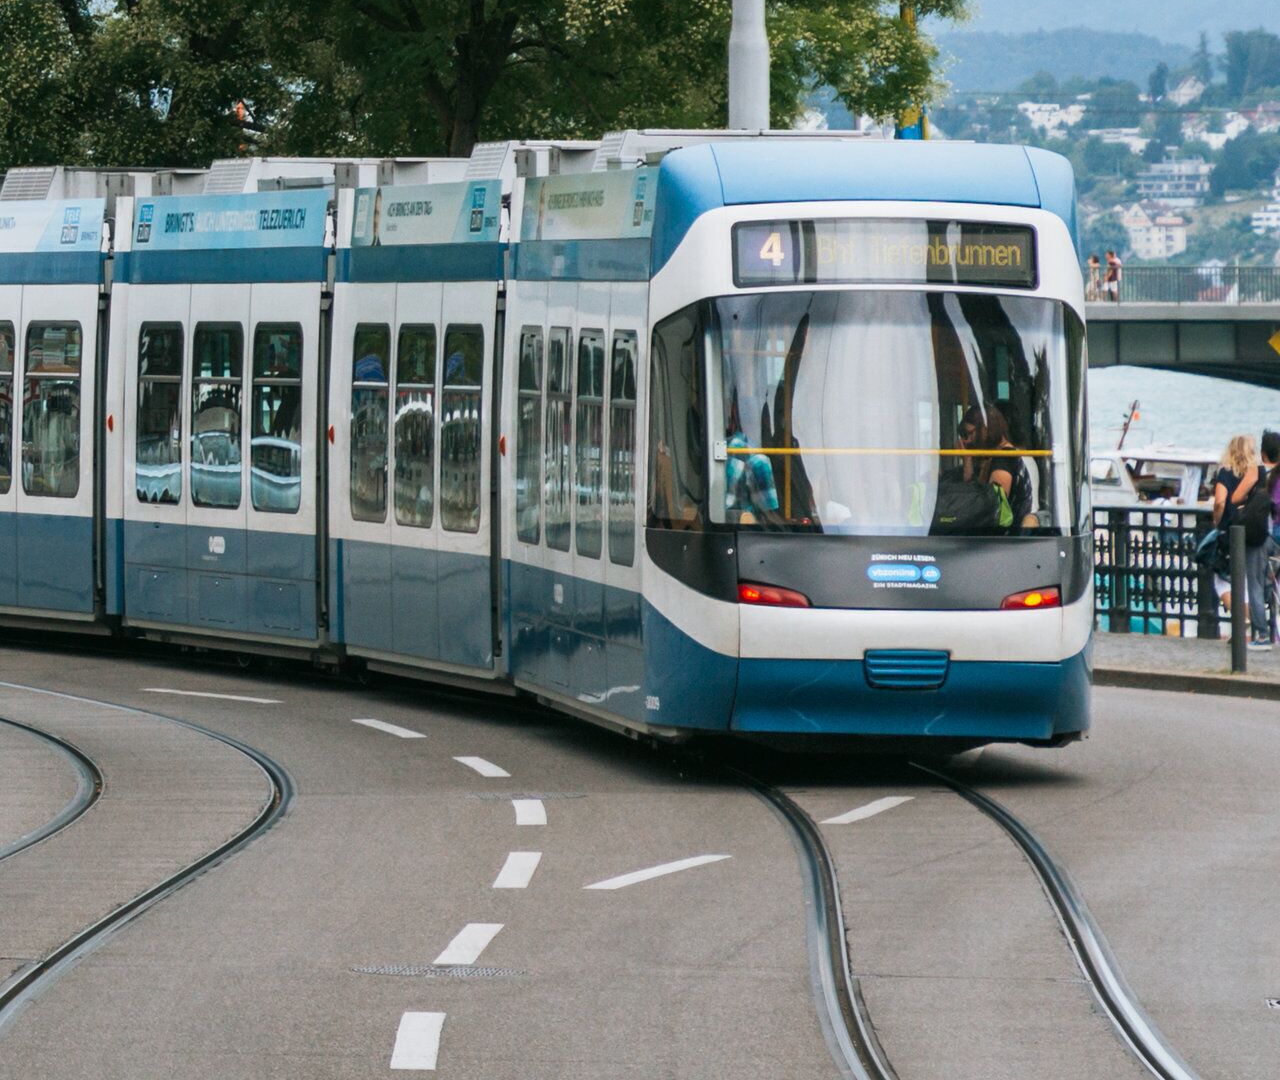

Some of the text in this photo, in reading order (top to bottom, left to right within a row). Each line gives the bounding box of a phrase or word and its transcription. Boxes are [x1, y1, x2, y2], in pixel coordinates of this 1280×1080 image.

[760, 232, 784, 267] 4
[871, 236, 1021, 265] Tiefenbrunnen
[871, 553, 897, 561] ZÜRICH
